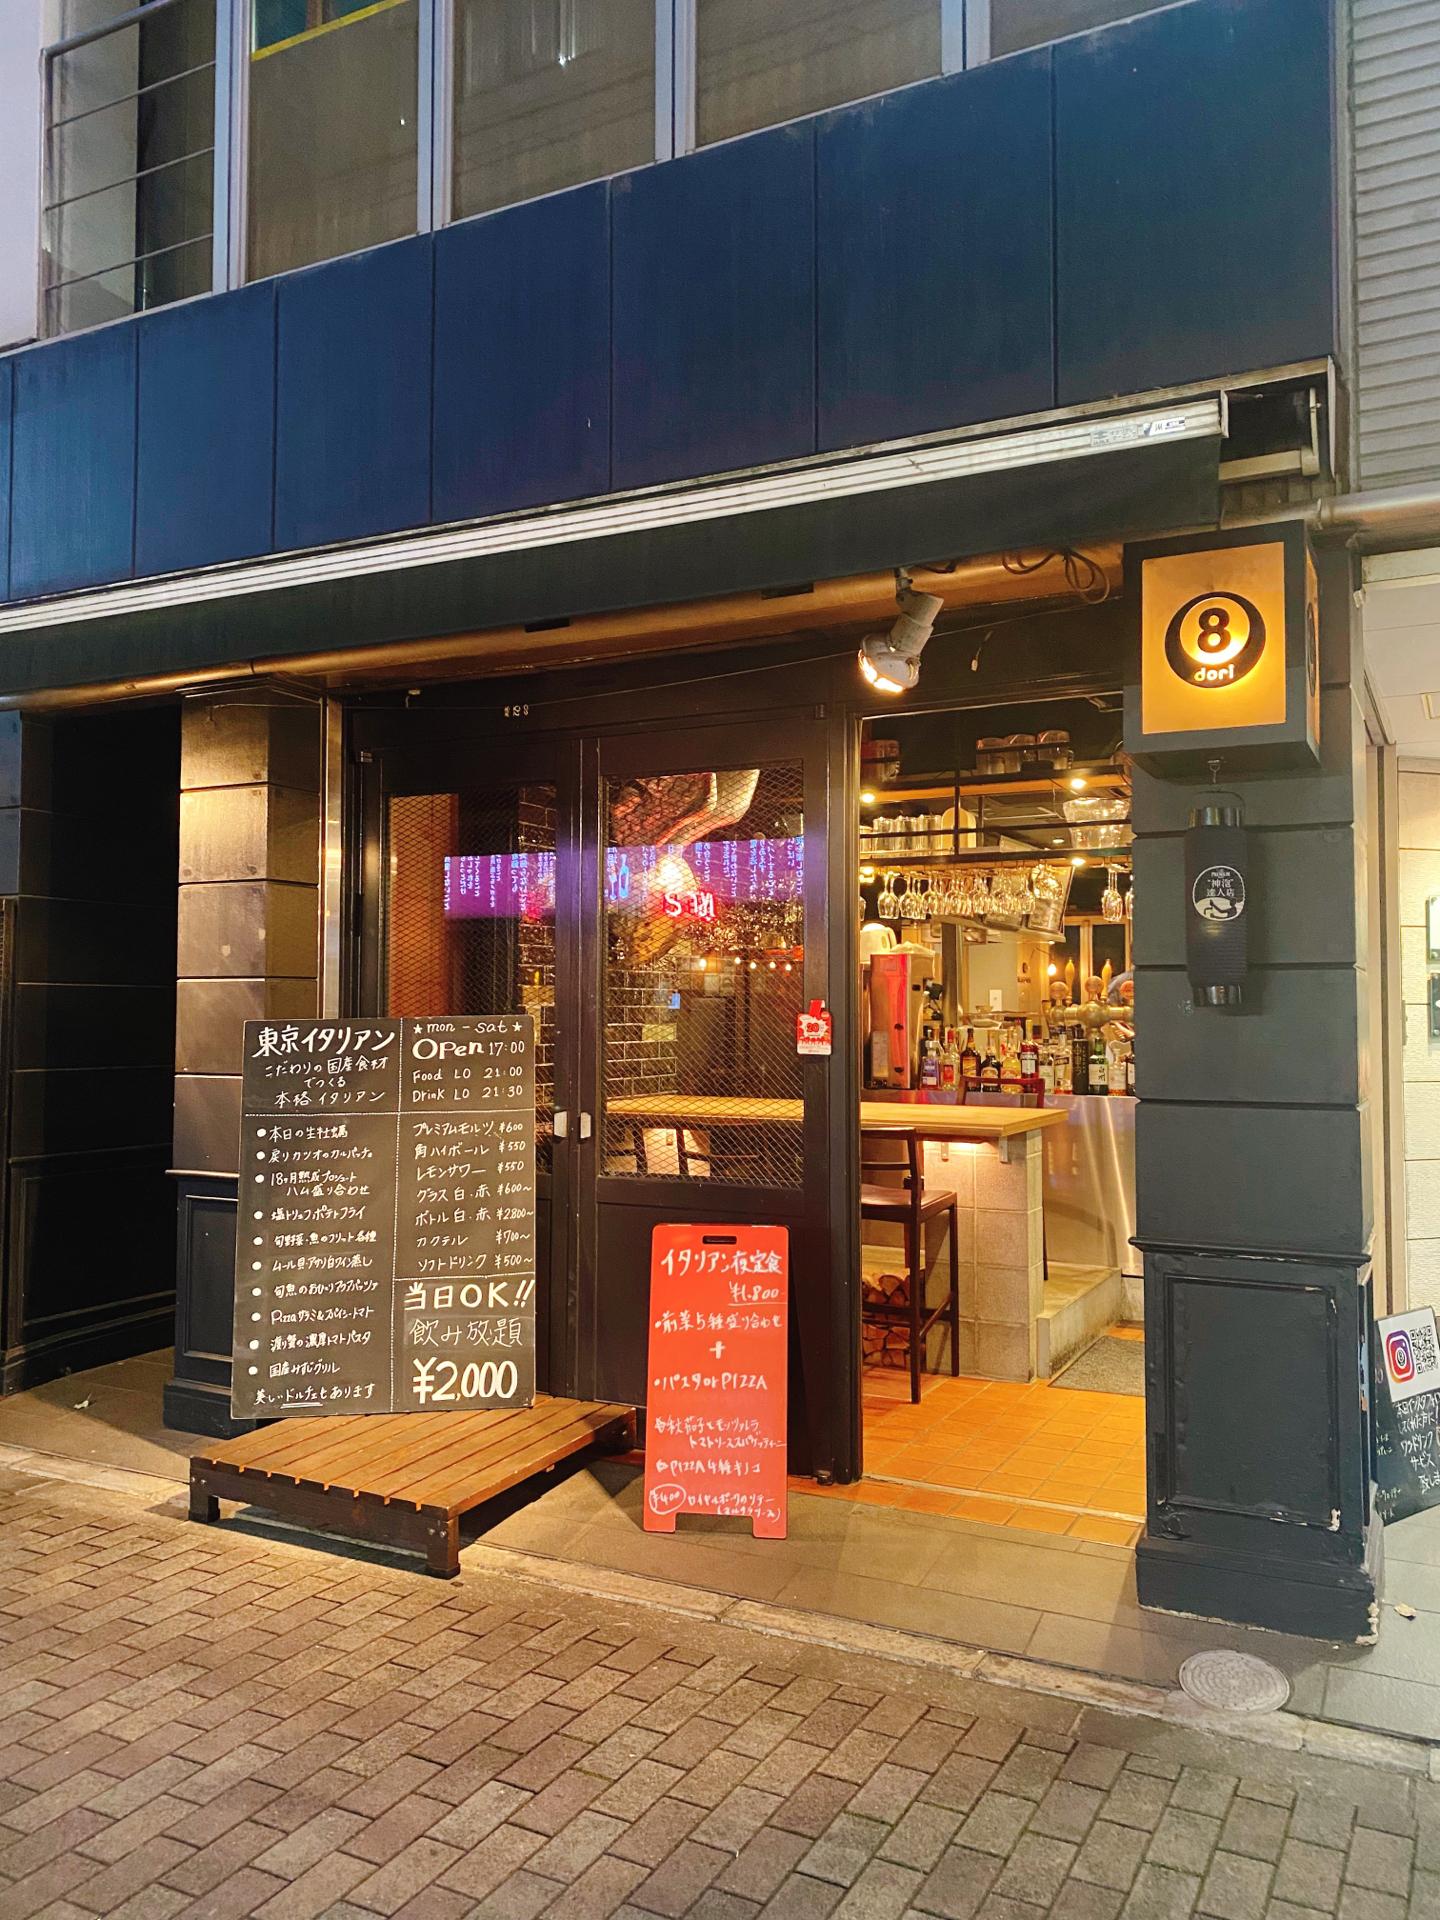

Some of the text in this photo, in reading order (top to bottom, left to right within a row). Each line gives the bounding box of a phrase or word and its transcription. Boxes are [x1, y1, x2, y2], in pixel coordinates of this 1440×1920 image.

[1197, 607, 1231, 654] 8
[1194, 664, 1234, 682] dori
[427, 1023, 455, 1033] mon
[474, 1020, 508, 1034] sat
[251, 1024, 396, 1058] 東京イタリアン
[489, 1041, 525, 1057] 17:00
[264, 1055, 389, 1078] こだわりの国産食材
[412, 1066, 523, 1084] Food LO 21:00
[304, 1076, 346, 1089] でつくる
[274, 1091, 385, 1109] 本格イタリアン
[454, 1088, 470, 1100] LO
[481, 1085, 523, 1098] 21:30
[268, 1124, 348, 1143] 本日の生牡蠣
[413, 1120, 524, 1137] プレミアムモルツ ¥600
[415, 1140, 526, 1160] 角ハイボール ¥550
[416, 1160, 525, 1181] レモンサワー ¥550
[286, 1183, 371, 1197] ハム盛り合わせ
[271, 1204, 367, 1221] 塩トリュフポテトフライ
[416, 1234, 469, 1248] カクテル
[418, 1254, 487, 1272] ソフトドリンク
[660, 1248, 783, 1276] イタリアン夜定食
[409, 1317, 523, 1348] 飲み放題
[269, 1358, 341, 1378] 国産みすじグリル
[412, 1356, 518, 1404] ¥2,000
[721, 1371, 768, 1391] PIZZA
[253, 1383, 376, 1405] 美しいドルチェもあります
